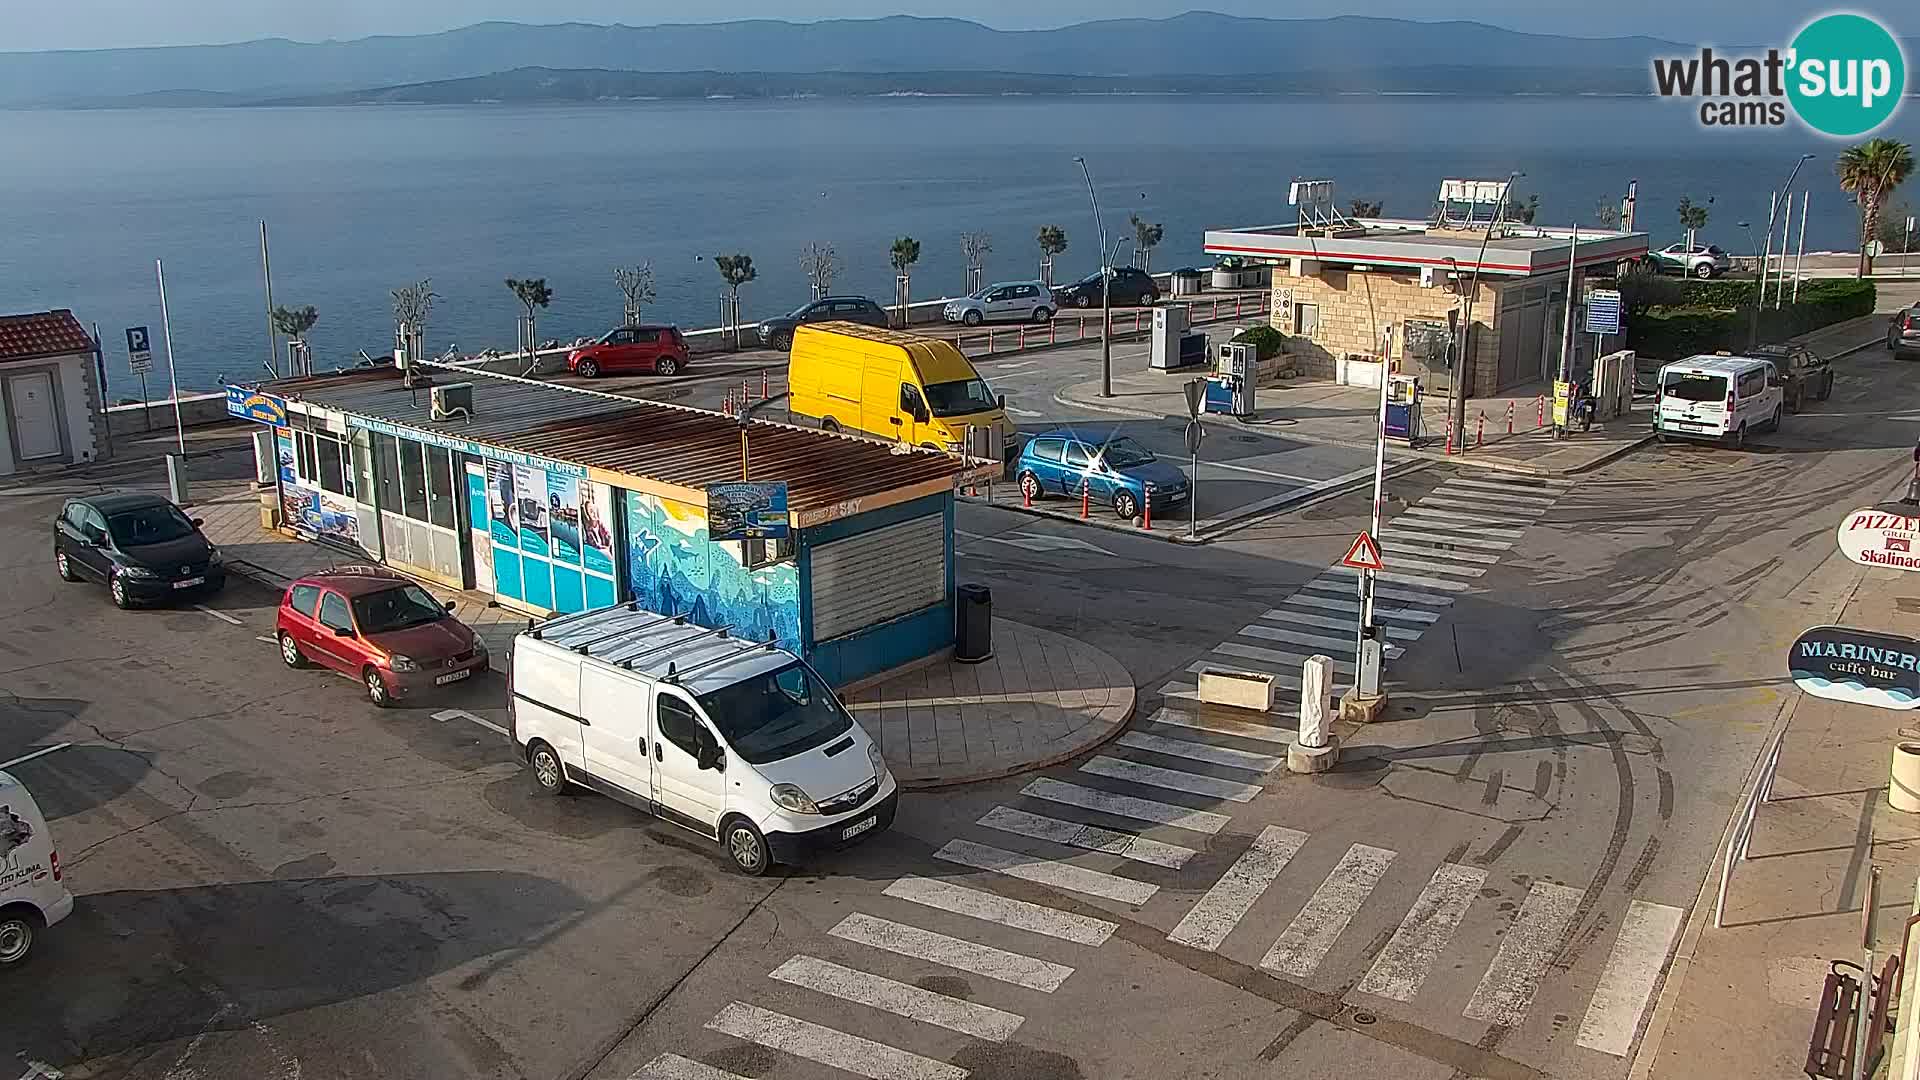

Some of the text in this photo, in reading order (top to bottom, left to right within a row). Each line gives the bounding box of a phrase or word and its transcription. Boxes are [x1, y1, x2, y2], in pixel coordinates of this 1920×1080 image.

[131, 330, 144, 349] P
[437, 433, 469, 451] POSTAJA
[480, 445, 494, 457] BUS
[494, 448, 527, 464] STATION
[528, 455, 556, 470] TICKET
[555, 461, 583, 476] OFFICE
[1848, 515, 1920, 532] PIZZE
[1882, 530, 1918, 540] GRILL
[1829, 661, 1897, 680] caffe bar
[16, 863, 41, 878] KLIMA
